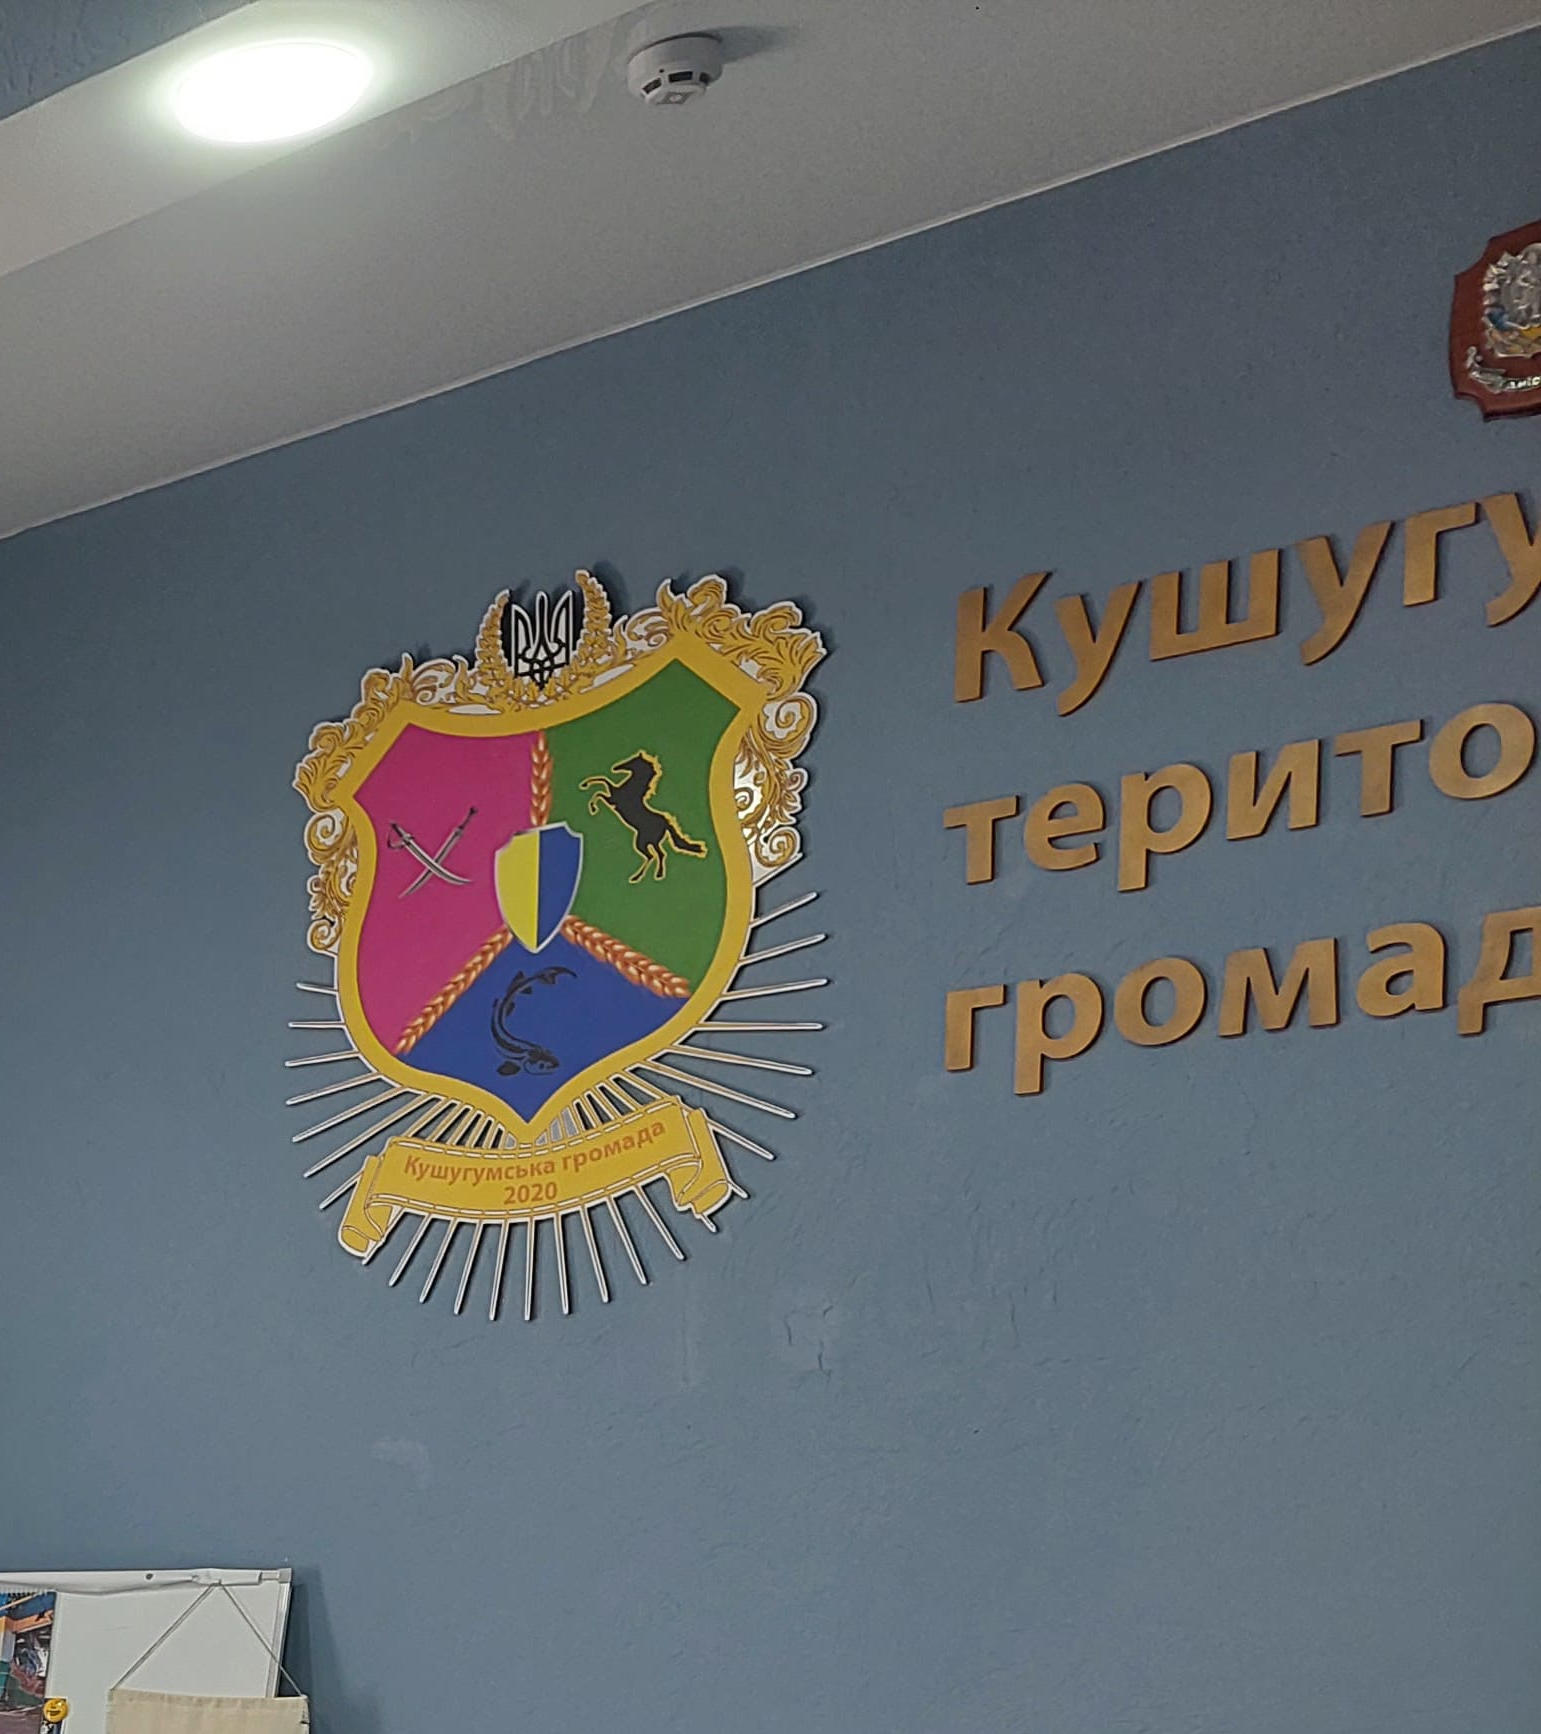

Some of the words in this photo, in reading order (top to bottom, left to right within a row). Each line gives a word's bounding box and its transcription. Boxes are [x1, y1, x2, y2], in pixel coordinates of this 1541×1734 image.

[942, 702, 1535, 892] терито
[404, 1154, 556, 1187] Кушугумська
[562, 1119, 666, 1174] громада
[503, 1182, 558, 1206] 2020
